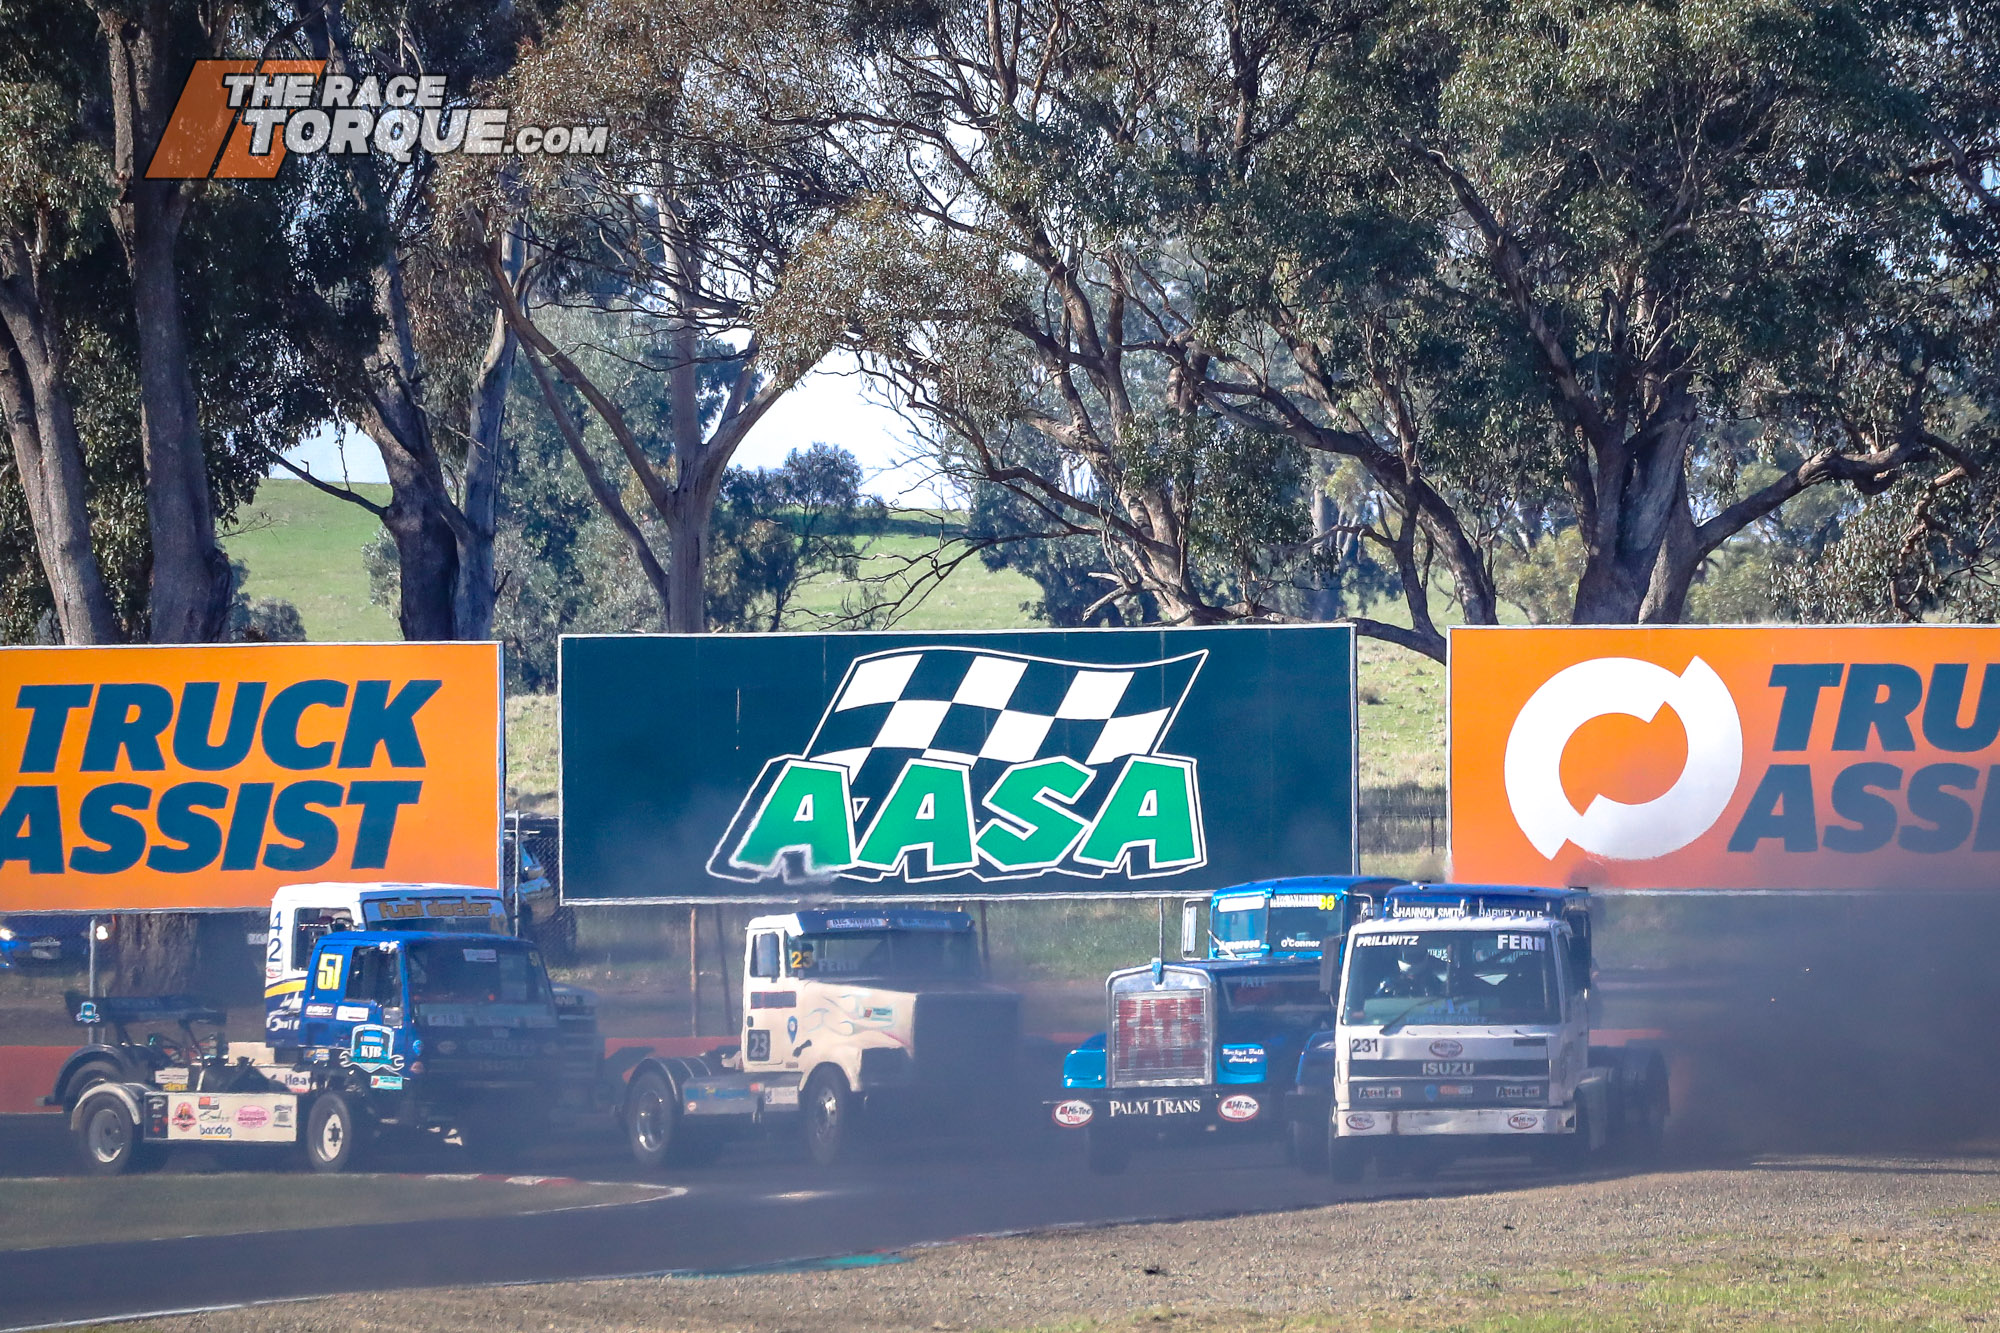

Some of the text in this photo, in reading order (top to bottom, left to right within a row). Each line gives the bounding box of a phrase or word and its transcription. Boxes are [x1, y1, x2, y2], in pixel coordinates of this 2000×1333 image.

[17, 679, 442, 773] TRUCK
[0, 780, 423, 874] ASSIST
[707, 754, 1207, 883] AASA
[377, 901, 492, 919] fuel doctor
[1392, 907, 1466, 919] SHANNON SMITH
[1478, 908, 1516, 918] HARVEY
[1280, 937, 1321, 948] O'Connor
[1356, 935, 1420, 948] PRILLWITZ
[791, 951, 814, 968] 23
[317, 953, 344, 990] 51
[750, 1033, 769, 1058] 23
[1352, 1038, 1379, 1053] 231
[1422, 1062, 1475, 1076] ISUZU
[1109, 1099, 1201, 1117] PALM TRANS
